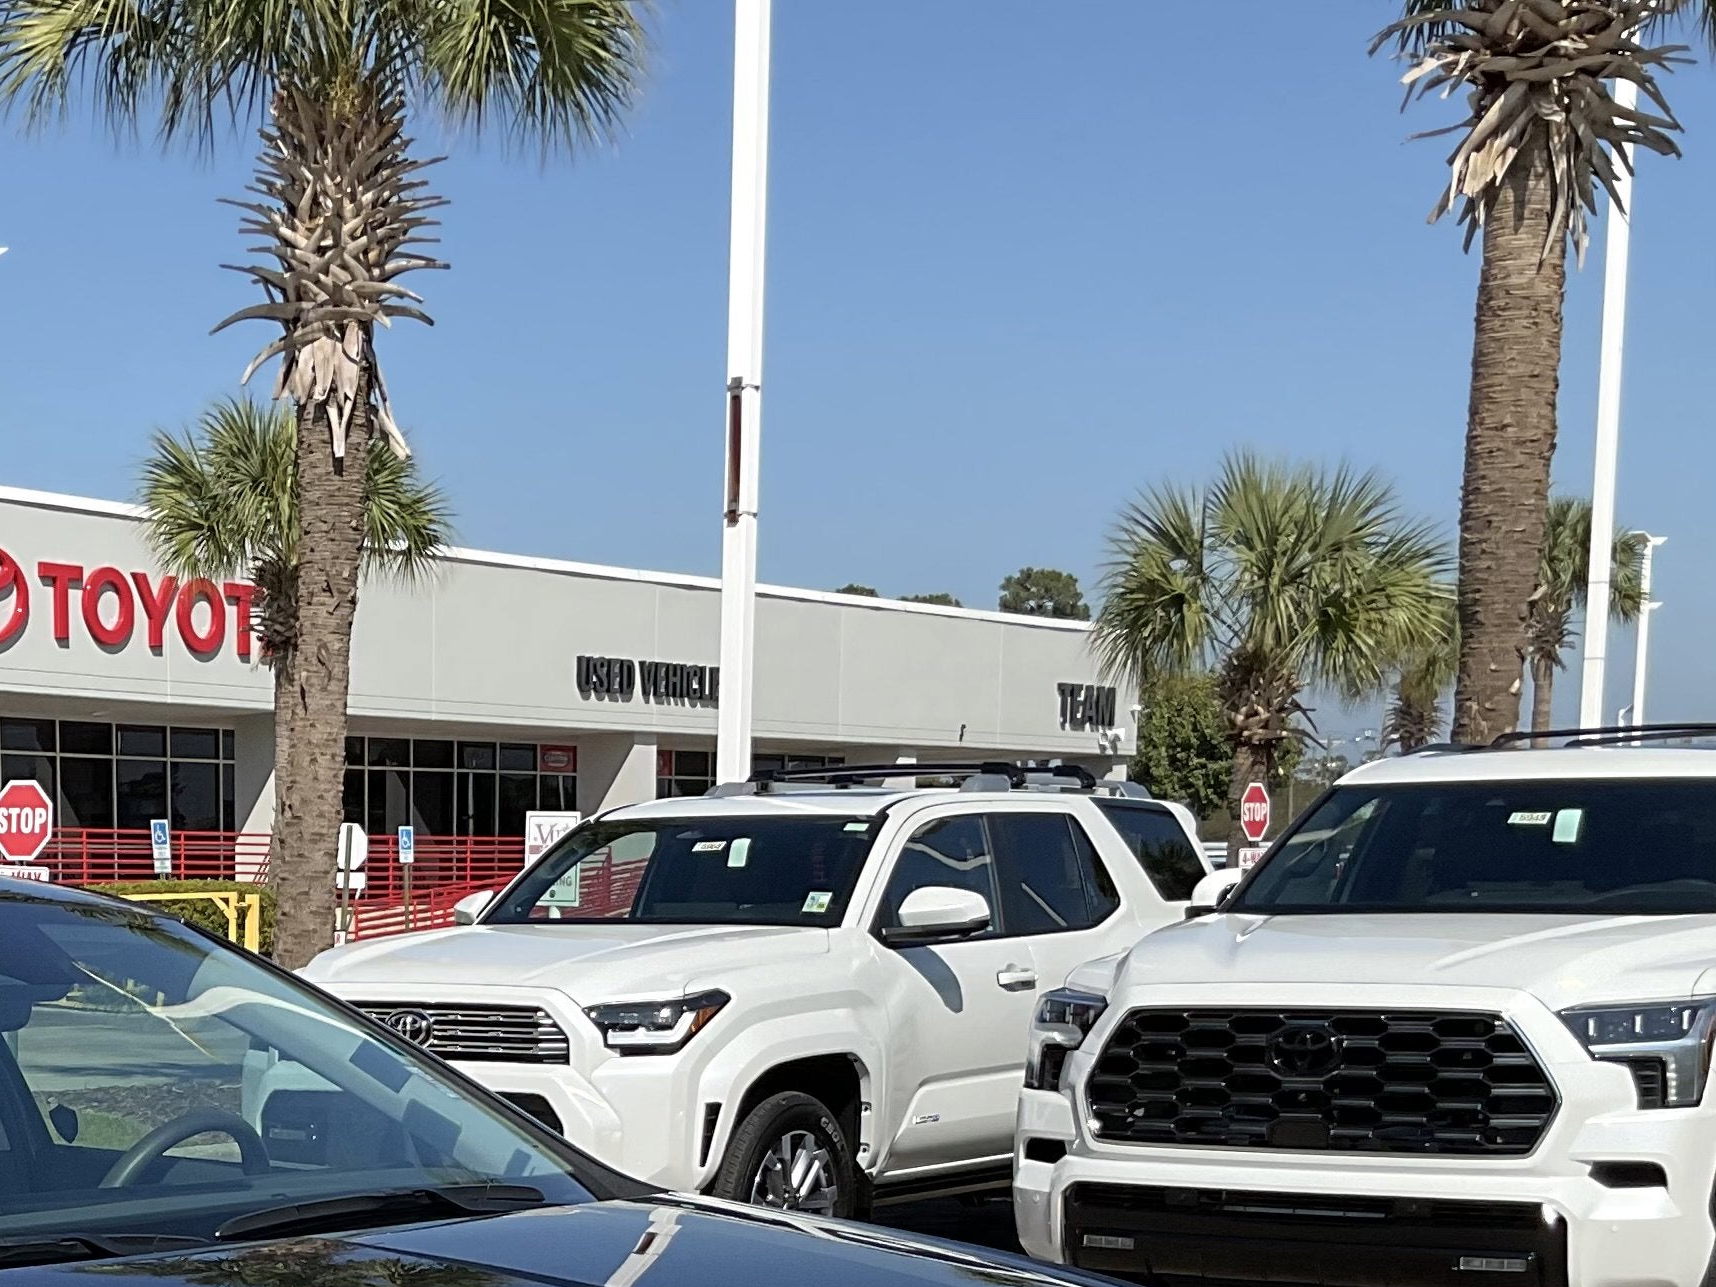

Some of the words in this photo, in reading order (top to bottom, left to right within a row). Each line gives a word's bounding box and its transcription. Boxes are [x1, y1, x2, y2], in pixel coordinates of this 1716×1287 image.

[37, 561, 274, 656] TOYOT
[576, 656, 635, 697] USED
[638, 661, 721, 702] VEHICLE
[1057, 682, 1116, 728] TEAM
[1244, 802, 1267, 822] STOP
[1243, 851, 1264, 864] 4-WA
